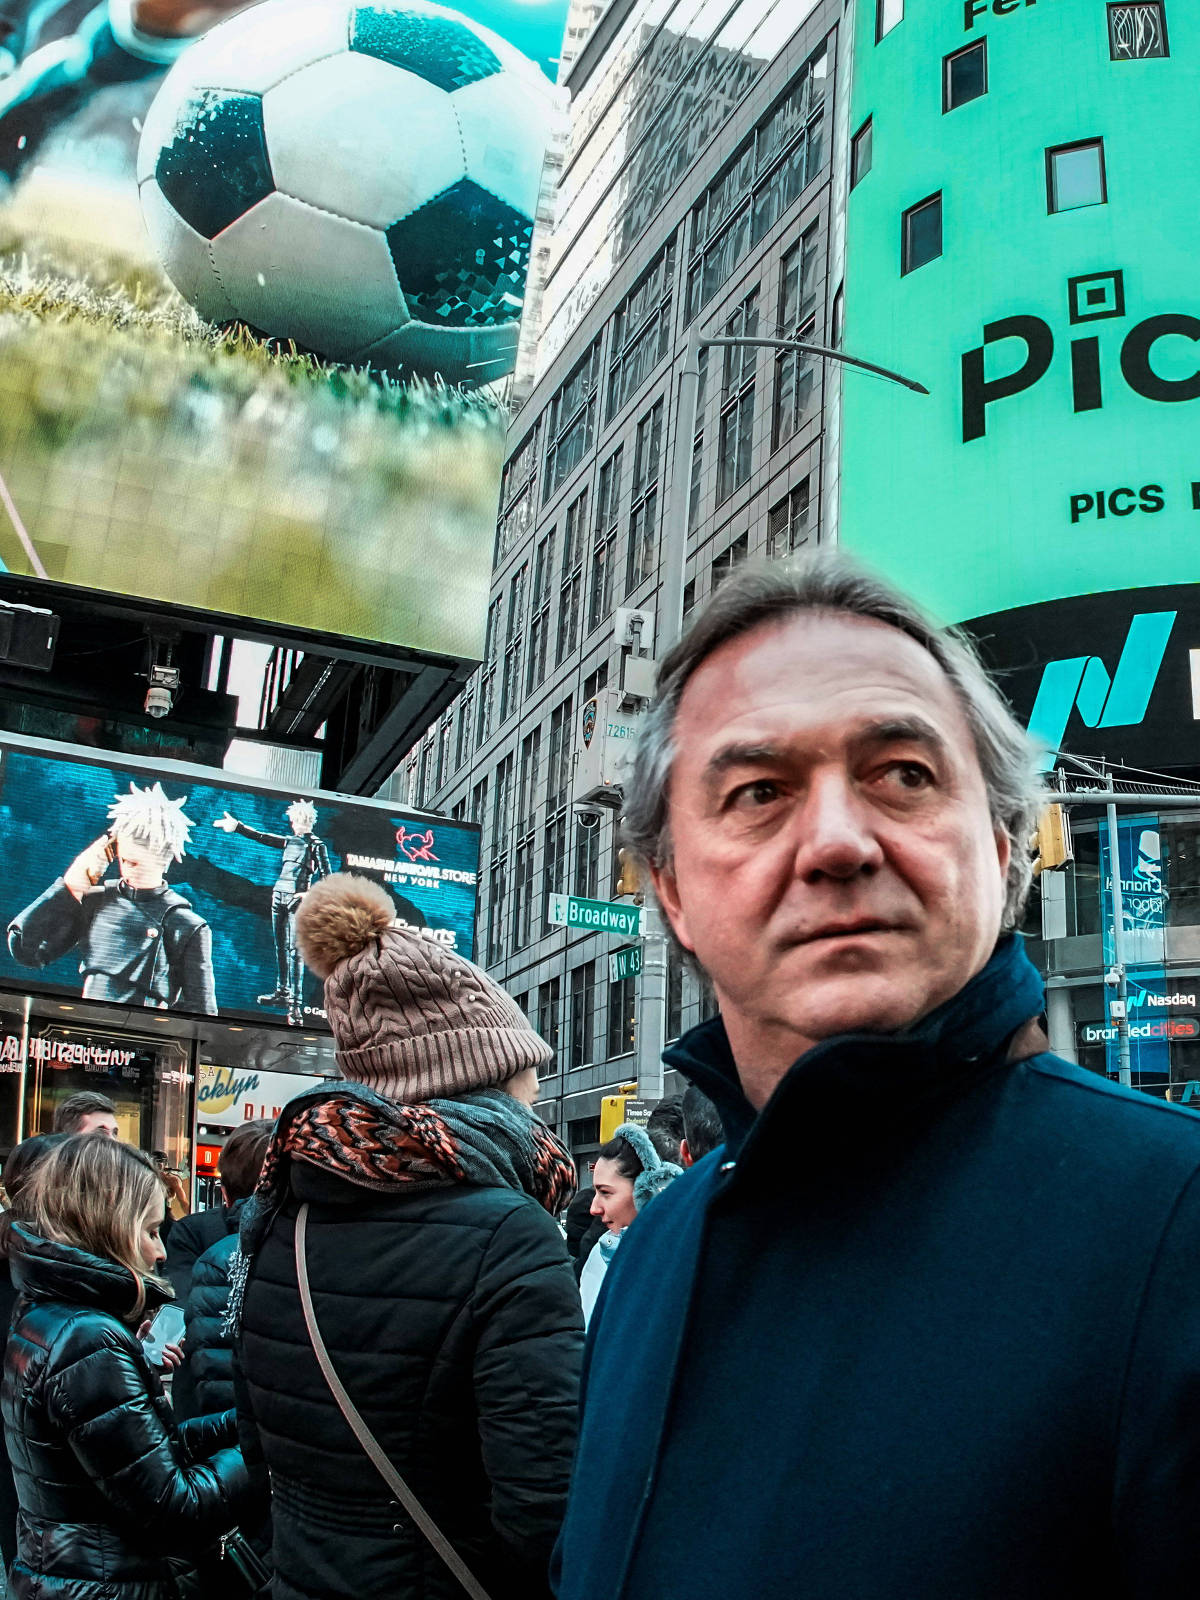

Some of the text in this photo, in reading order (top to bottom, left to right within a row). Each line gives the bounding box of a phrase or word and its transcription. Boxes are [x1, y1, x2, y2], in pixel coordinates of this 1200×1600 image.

[964, 0, 1037, 32] Fe
[1070, 484, 1165, 524] PICS
[384, 873, 440, 889] NEW YORK
[441, 868, 477, 885] STORE
[569, 902, 635, 935] Broadway
[619, 955, 627, 976] W
[1147, 993, 1196, 1007] Nasdaq
[1086, 1021, 1195, 1041] branedcities
